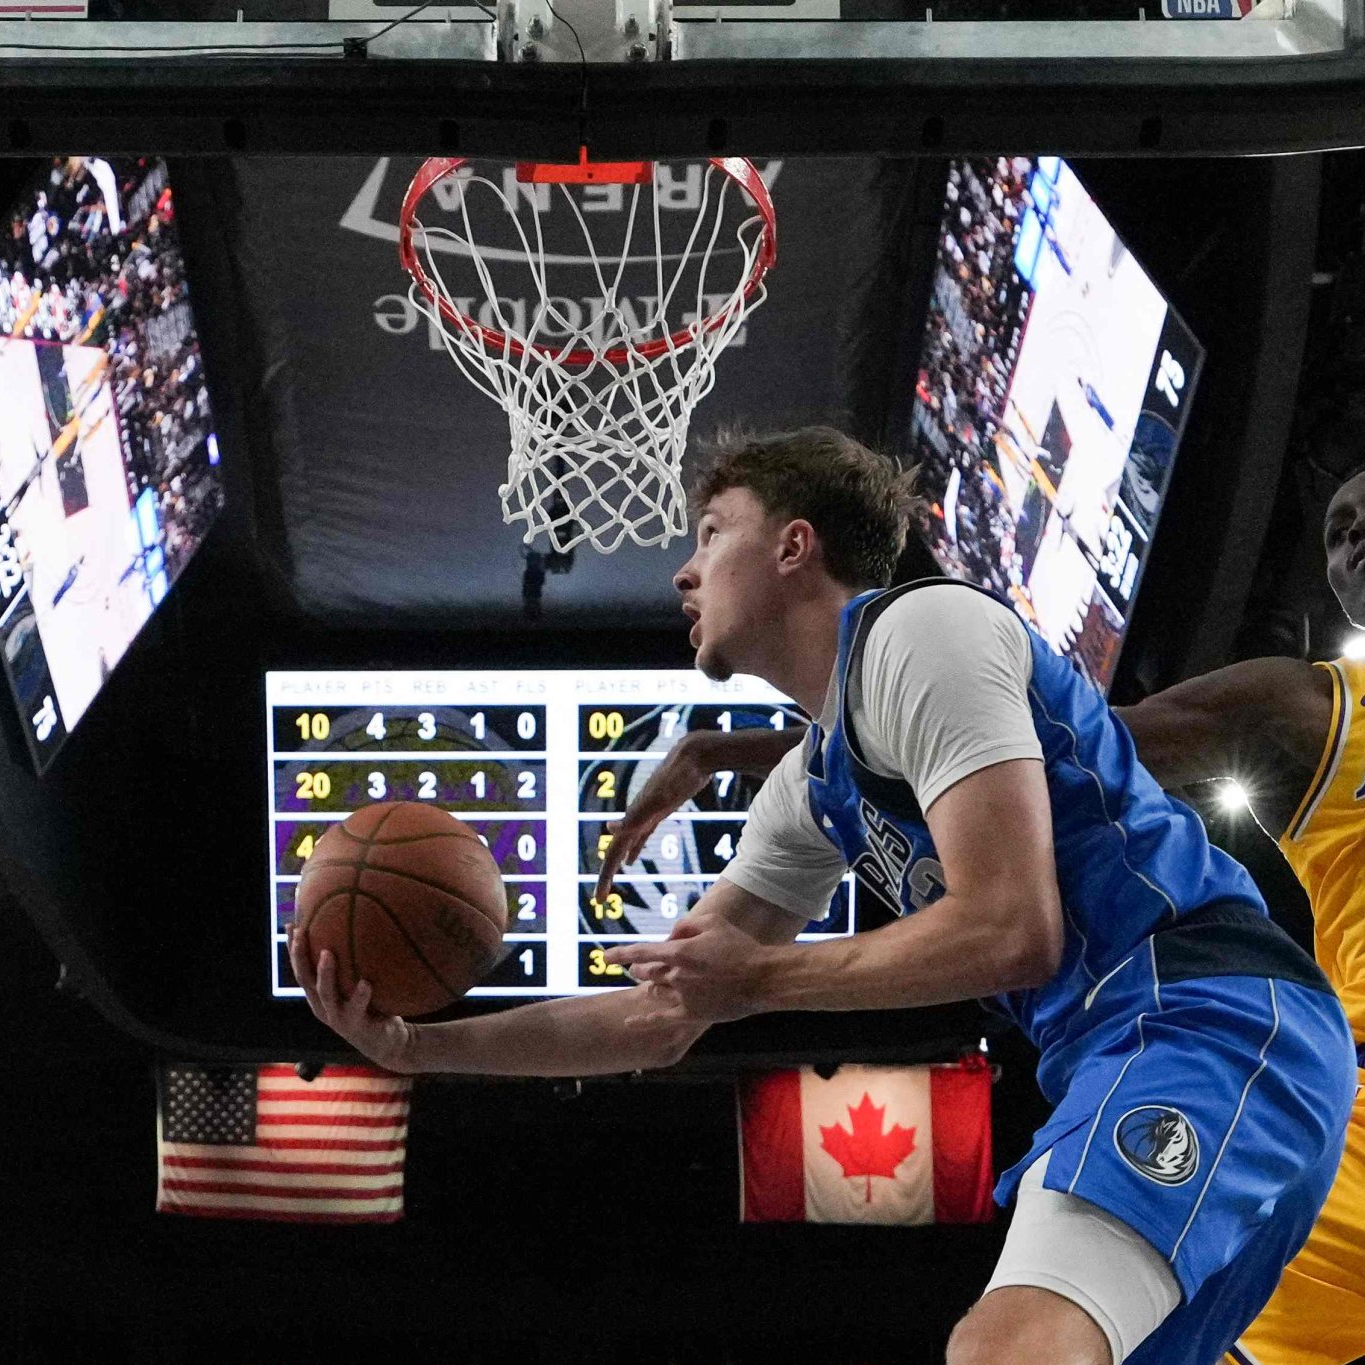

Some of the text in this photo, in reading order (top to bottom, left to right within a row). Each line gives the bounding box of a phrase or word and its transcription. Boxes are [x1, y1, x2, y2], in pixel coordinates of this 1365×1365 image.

[1177, 0, 1221, 14] NBA
[281, 680, 346, 694] PLAYER
[362, 680, 393, 694] PTS
[413, 680, 446, 694] REB
[467, 679, 498, 693] AST
[575, 679, 641, 693] PLAYER
[658, 678, 688, 692] PTS
[296, 711, 537, 740] 10 4 3 1 0
[589, 710, 784, 739] 00 7 1 1
[295, 771, 537, 799] 20 3 2 1 2
[597, 771, 734, 799] 2 7
[296, 835, 324, 860] 4
[517, 834, 537, 861] 0
[660, 833, 679, 860] 6
[714, 833, 734, 861] 4
[517, 893, 537, 921] 2
[590, 893, 679, 920] 13 6
[519, 948, 534, 976] 1
